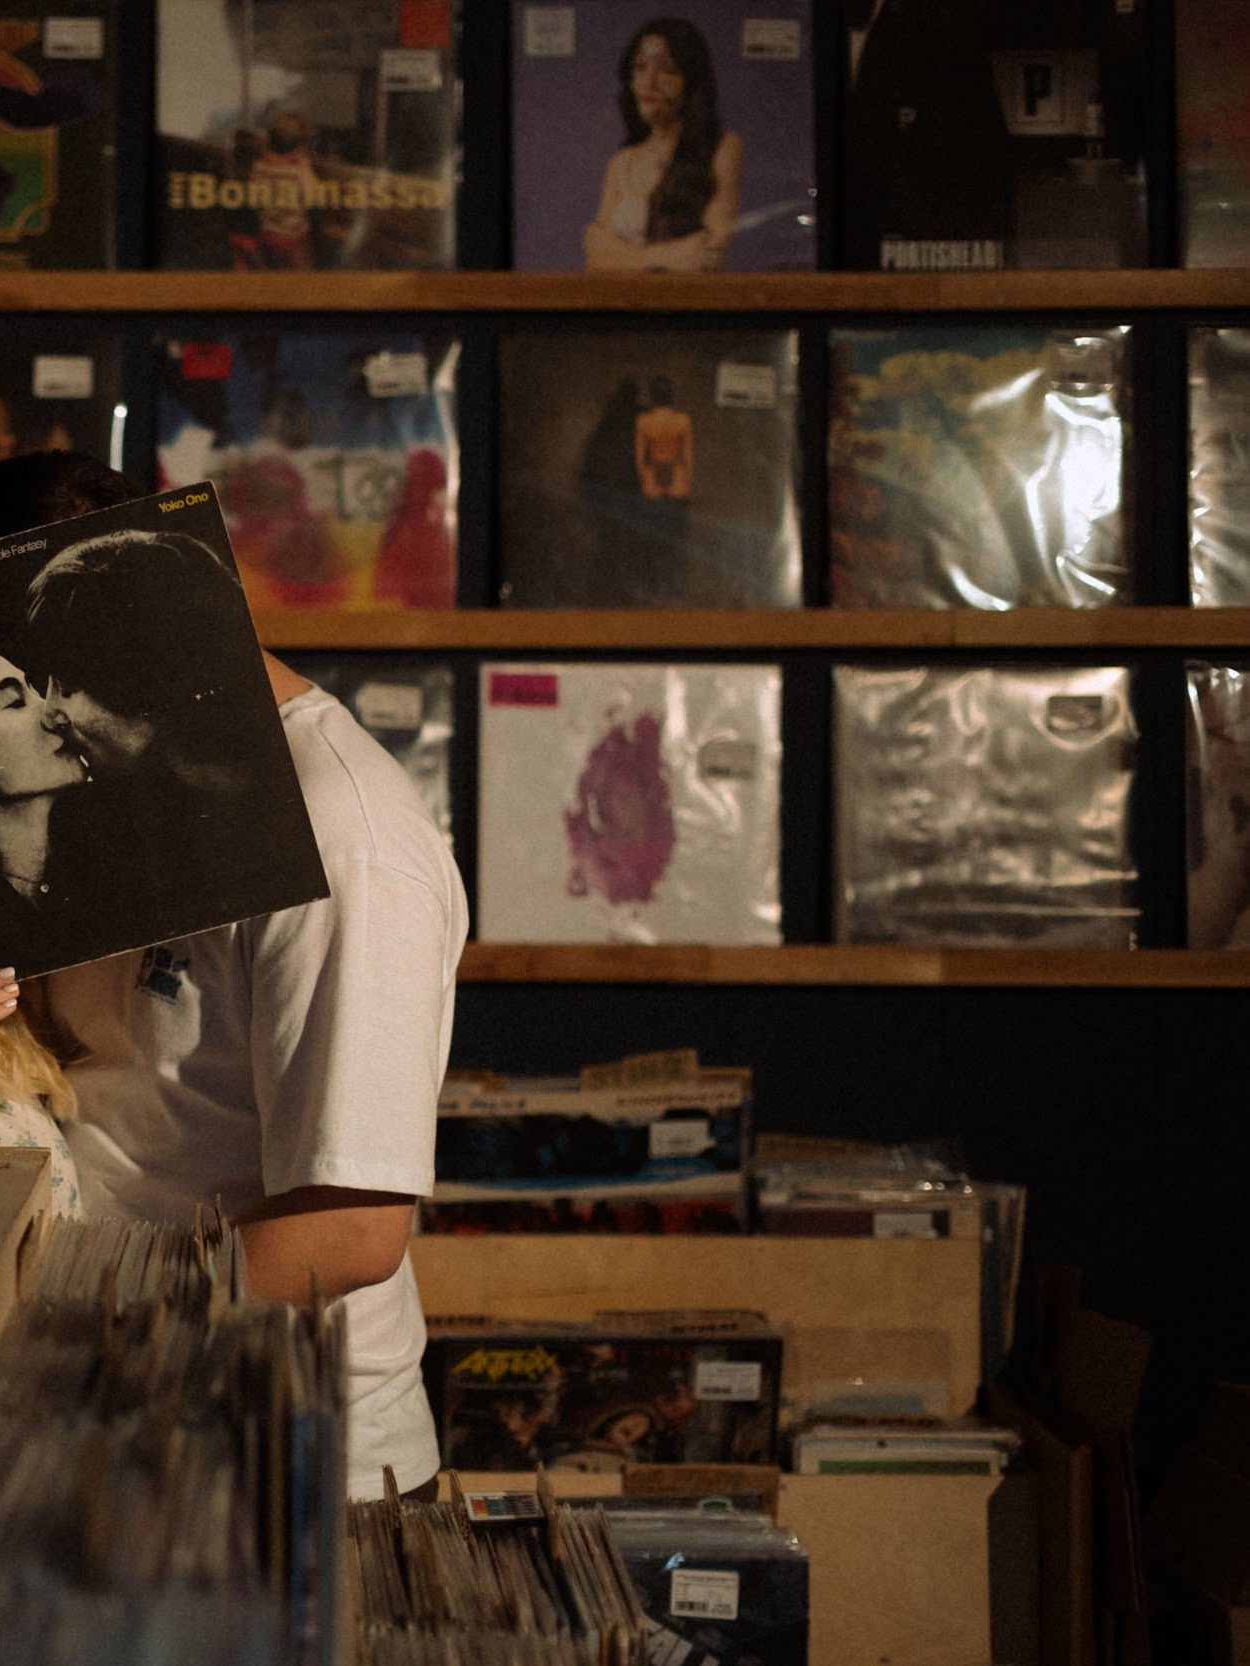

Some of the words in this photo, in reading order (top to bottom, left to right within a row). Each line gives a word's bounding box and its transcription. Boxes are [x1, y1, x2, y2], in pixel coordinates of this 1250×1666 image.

[1024, 63, 1052, 117] P
[187, 170, 447, 210] Bonamassa
[158, 500, 184, 513] Yoko
[185, 493, 209, 506] Ono
[10, 538, 48, 556] Fantasy
